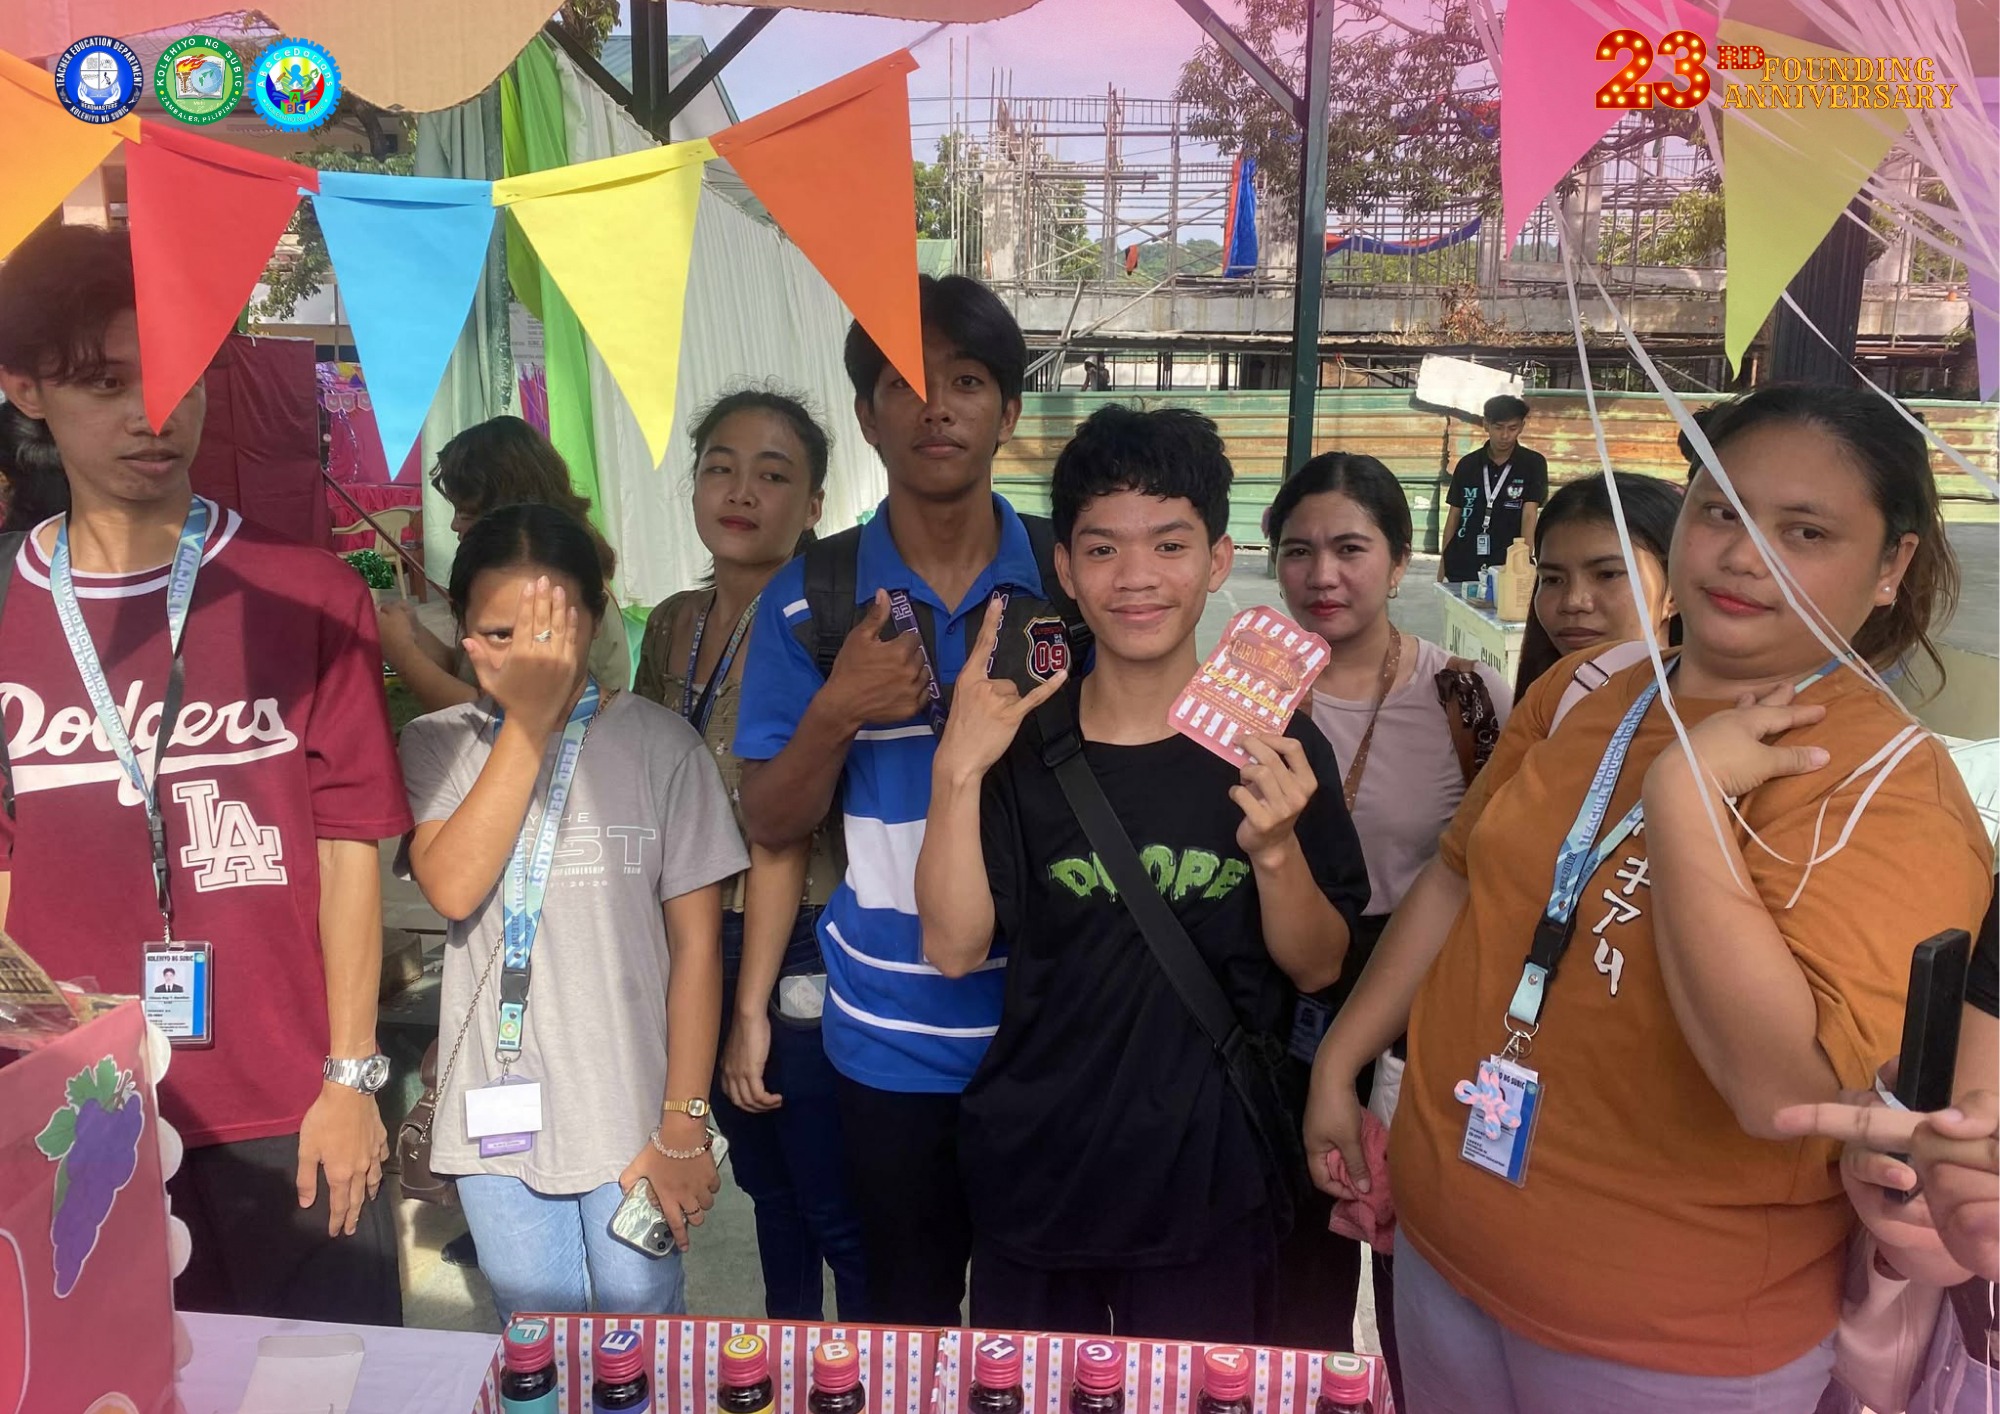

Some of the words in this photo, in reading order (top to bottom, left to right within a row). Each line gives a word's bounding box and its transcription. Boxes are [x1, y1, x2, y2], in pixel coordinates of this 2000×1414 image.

[1457, 487, 1479, 538] MEDIC
[171, 547, 198, 601] MAJOR
[75, 625, 109, 698] EDUCATION
[1034, 640, 1067, 674] 09
[0, 680, 298, 807] Dodgers
[555, 741, 578, 780] BEED
[1577, 783, 1613, 845] TEACHER
[1602, 712, 1643, 786] EDUCATION
[172, 779, 289, 893] LA
[529, 787, 566, 890] GENERALIST
[517, 1323, 544, 1340] F
[601, 1332, 635, 1351] E
[730, 1336, 758, 1353] C
[824, 1342, 850, 1361] B
[980, 1338, 1015, 1360] H
[1086, 1344, 1114, 1361] G
[1211, 1353, 1240, 1369] A
[1336, 1355, 1360, 1372] D
